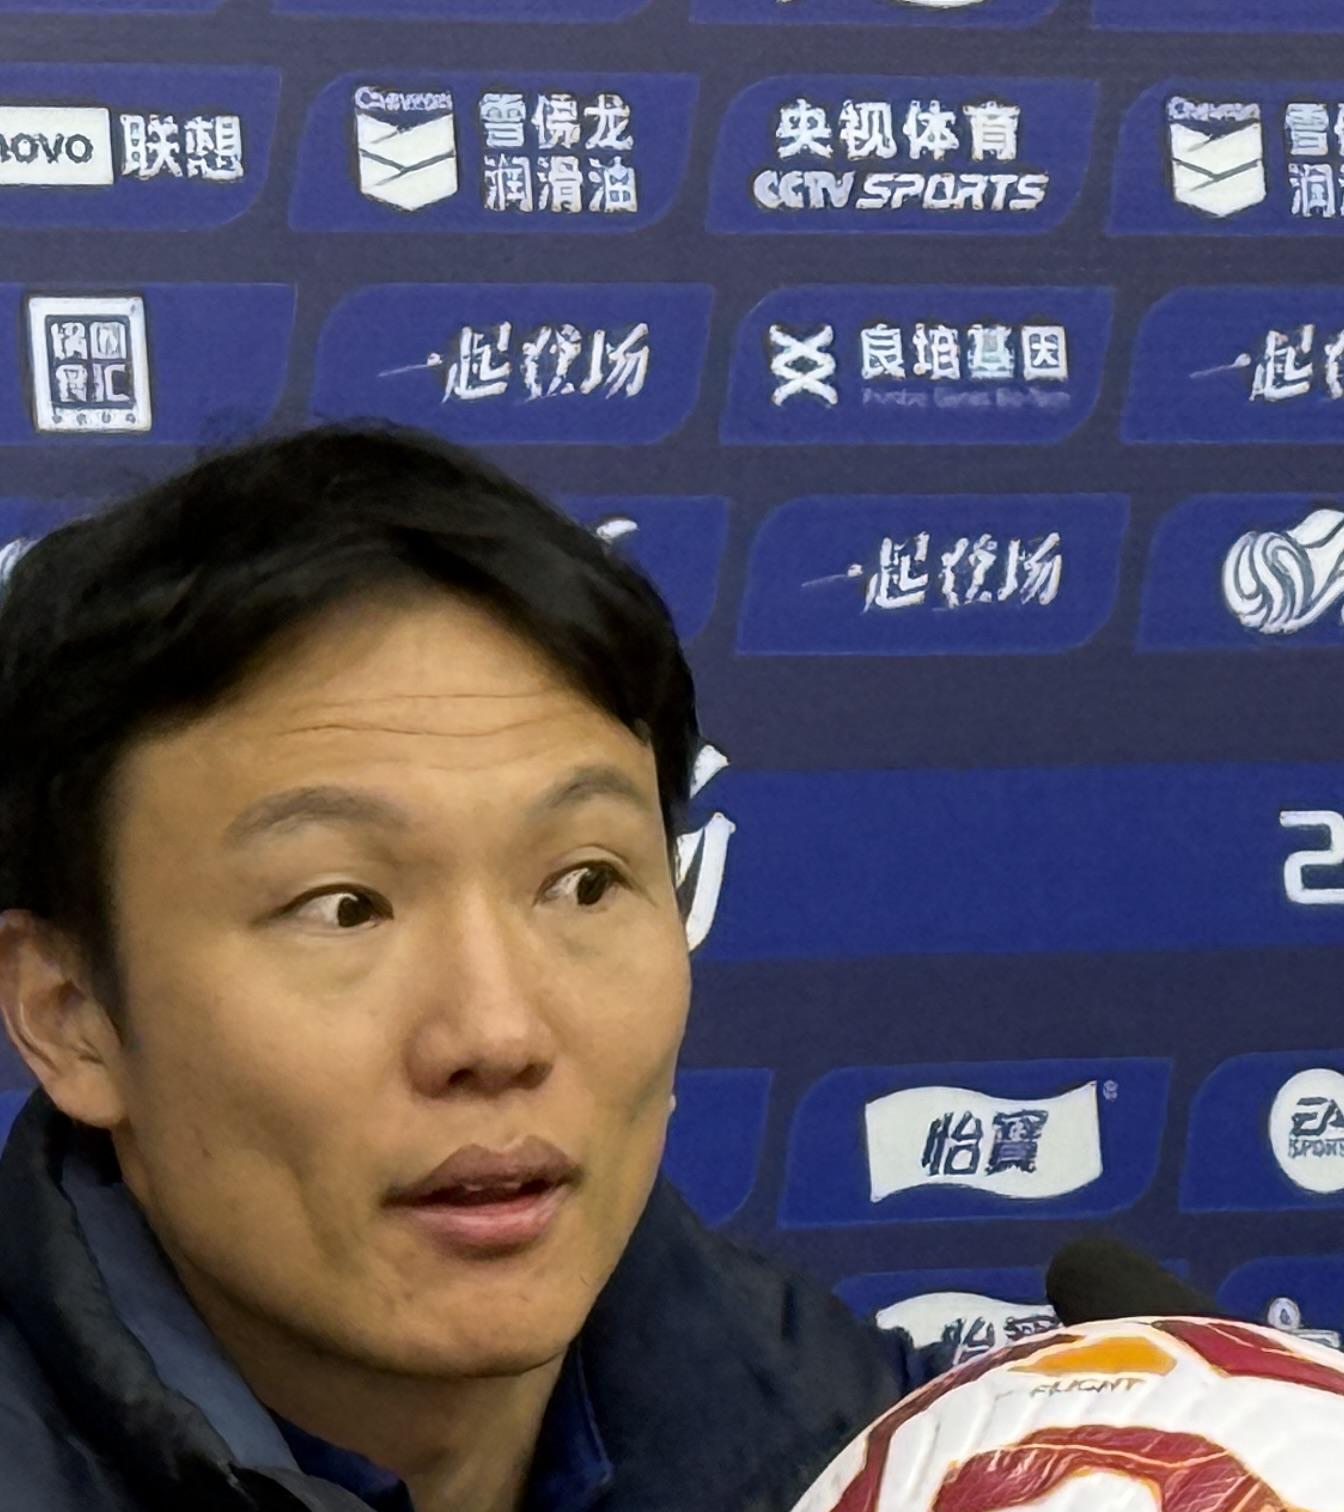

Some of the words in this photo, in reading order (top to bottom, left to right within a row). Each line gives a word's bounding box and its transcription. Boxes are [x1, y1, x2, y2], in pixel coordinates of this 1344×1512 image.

[120, 115, 243, 179] 联想
[479, 93, 633, 150] 雪佛龙
[776, 99, 1020, 160] 央视体育
[484, 154, 636, 212] 润滑油
[754, 170, 854, 208] CCTV
[857, 172, 1049, 210] SPORTS
[379, 322, 649, 403] 一起登场
[922, 1109, 1048, 1176] 怡寶
